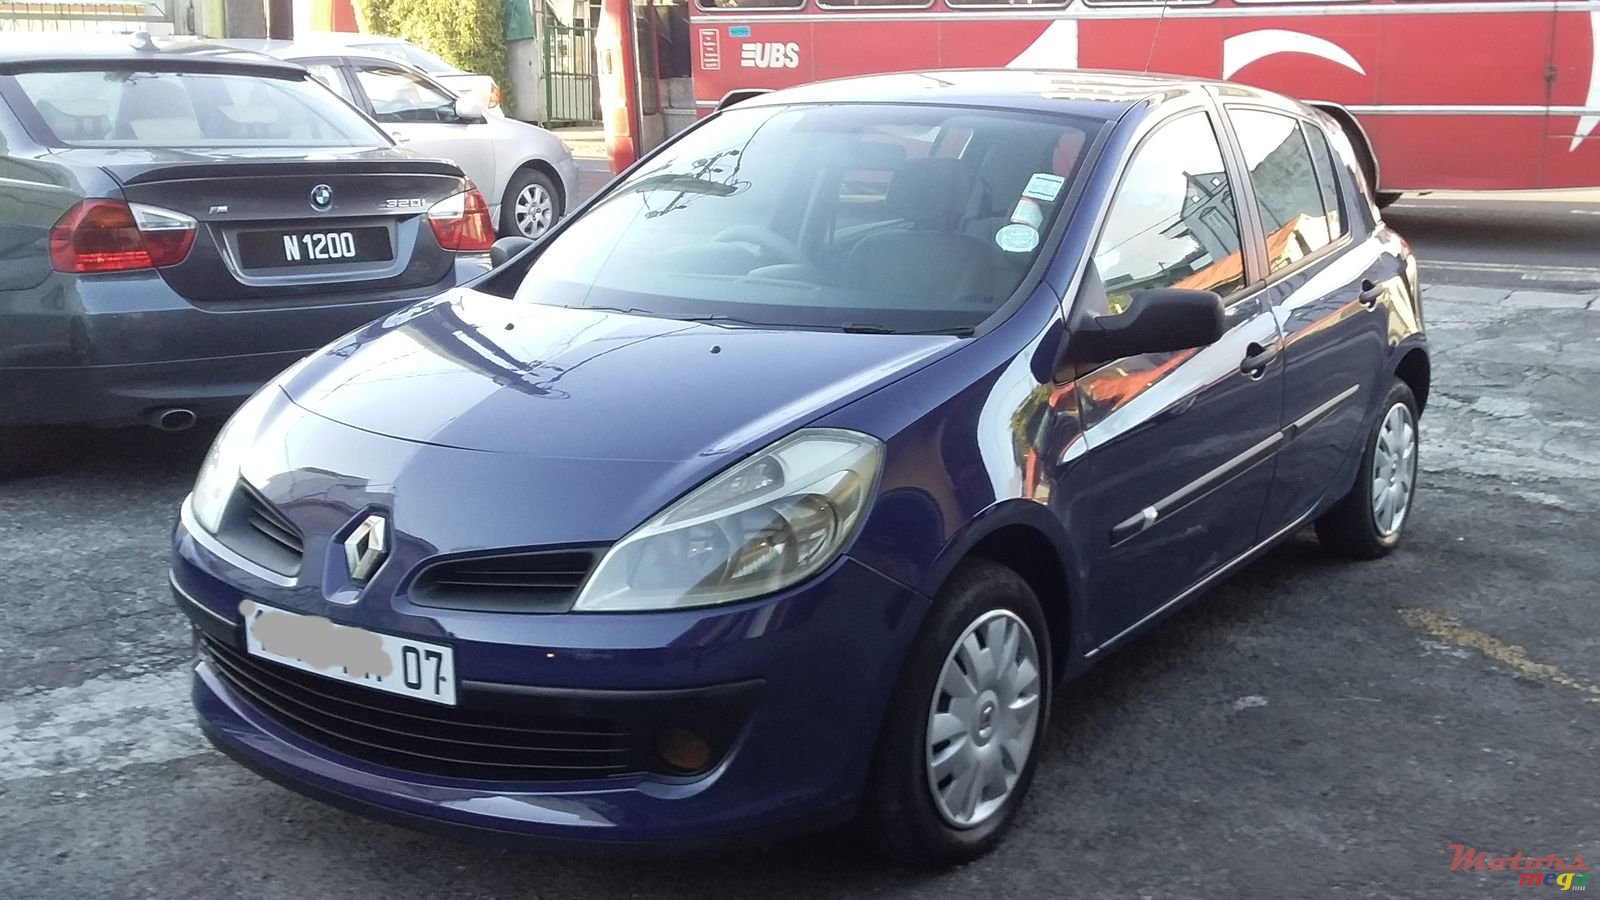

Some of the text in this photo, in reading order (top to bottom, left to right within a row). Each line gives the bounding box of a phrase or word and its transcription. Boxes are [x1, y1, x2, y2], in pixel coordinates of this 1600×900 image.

[755, 41, 800, 69] UBS
[283, 232, 356, 261] N 1200
[402, 645, 443, 695] 07
